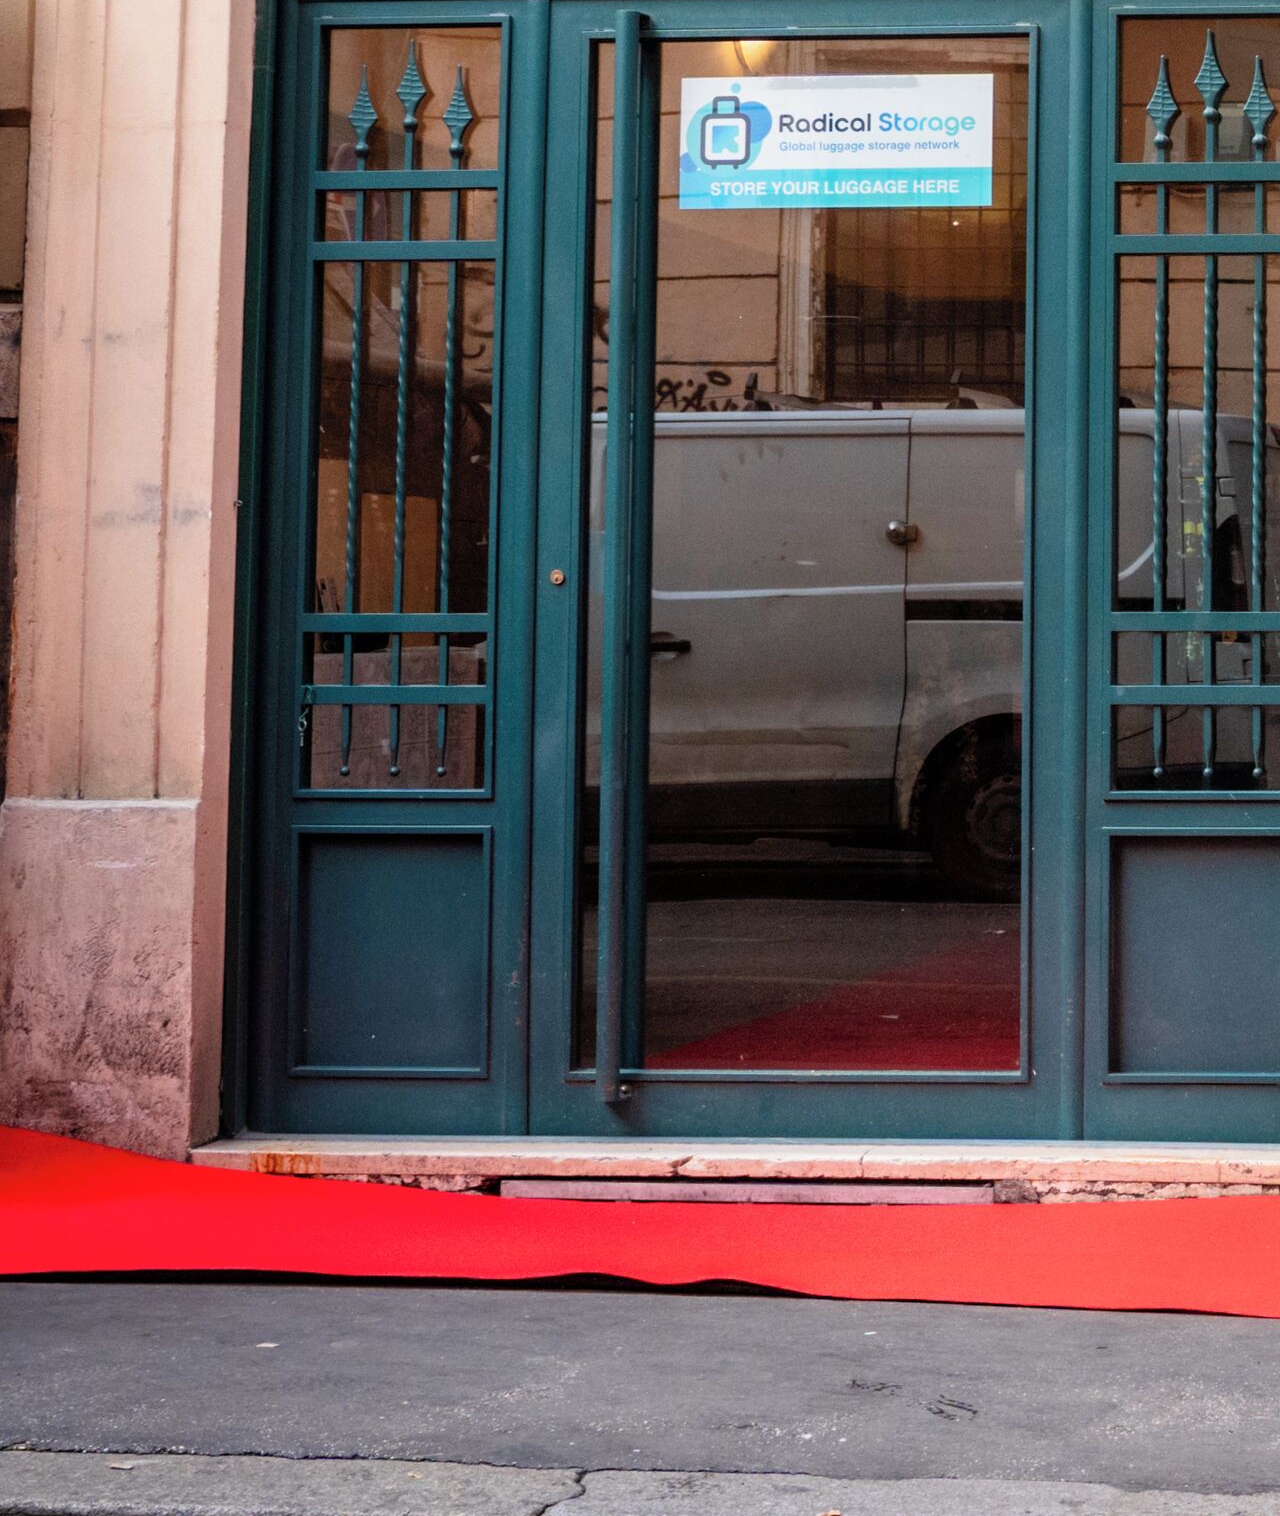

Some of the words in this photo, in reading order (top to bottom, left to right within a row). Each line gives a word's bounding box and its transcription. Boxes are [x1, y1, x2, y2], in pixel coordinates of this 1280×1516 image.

[778, 112, 871, 134] Radical
[878, 112, 976, 136] Storage
[779, 140, 816, 152] Global
[819, 140, 865, 154] luggage
[868, 140, 911, 153] storage
[914, 139, 960, 150] network
[710, 181, 768, 197] STORE
[771, 180, 820, 196] YOUR
[823, 179, 909, 195] LUGGAGE
[913, 179, 960, 194] HERE
